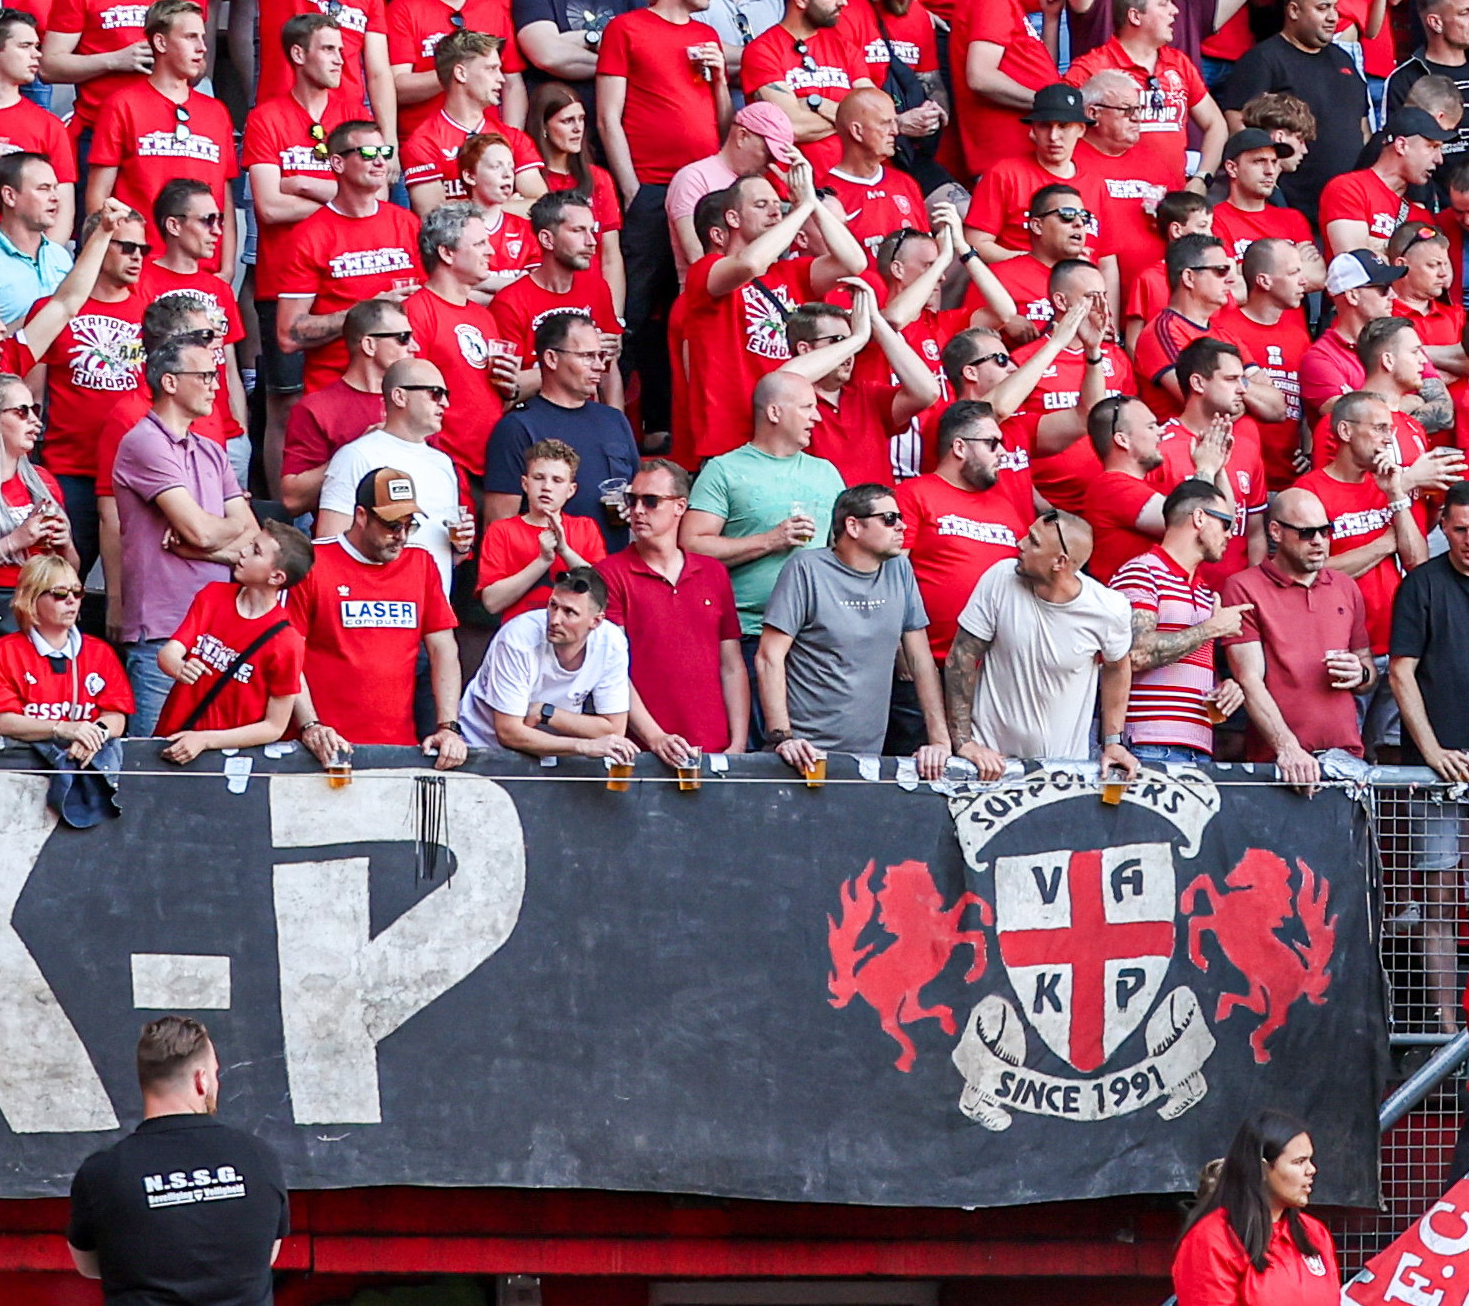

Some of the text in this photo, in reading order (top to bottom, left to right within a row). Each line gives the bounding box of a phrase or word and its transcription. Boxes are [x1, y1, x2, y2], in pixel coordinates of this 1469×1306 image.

[343, 602, 414, 619] LASER
[344, 618, 415, 628] computer
[1031, 865, 1064, 905] V
[1032, 971, 1064, 1015] K
[994, 1063, 1167, 1115] SINCE 1991
[143, 1165, 244, 1194] N.S.S.G.
